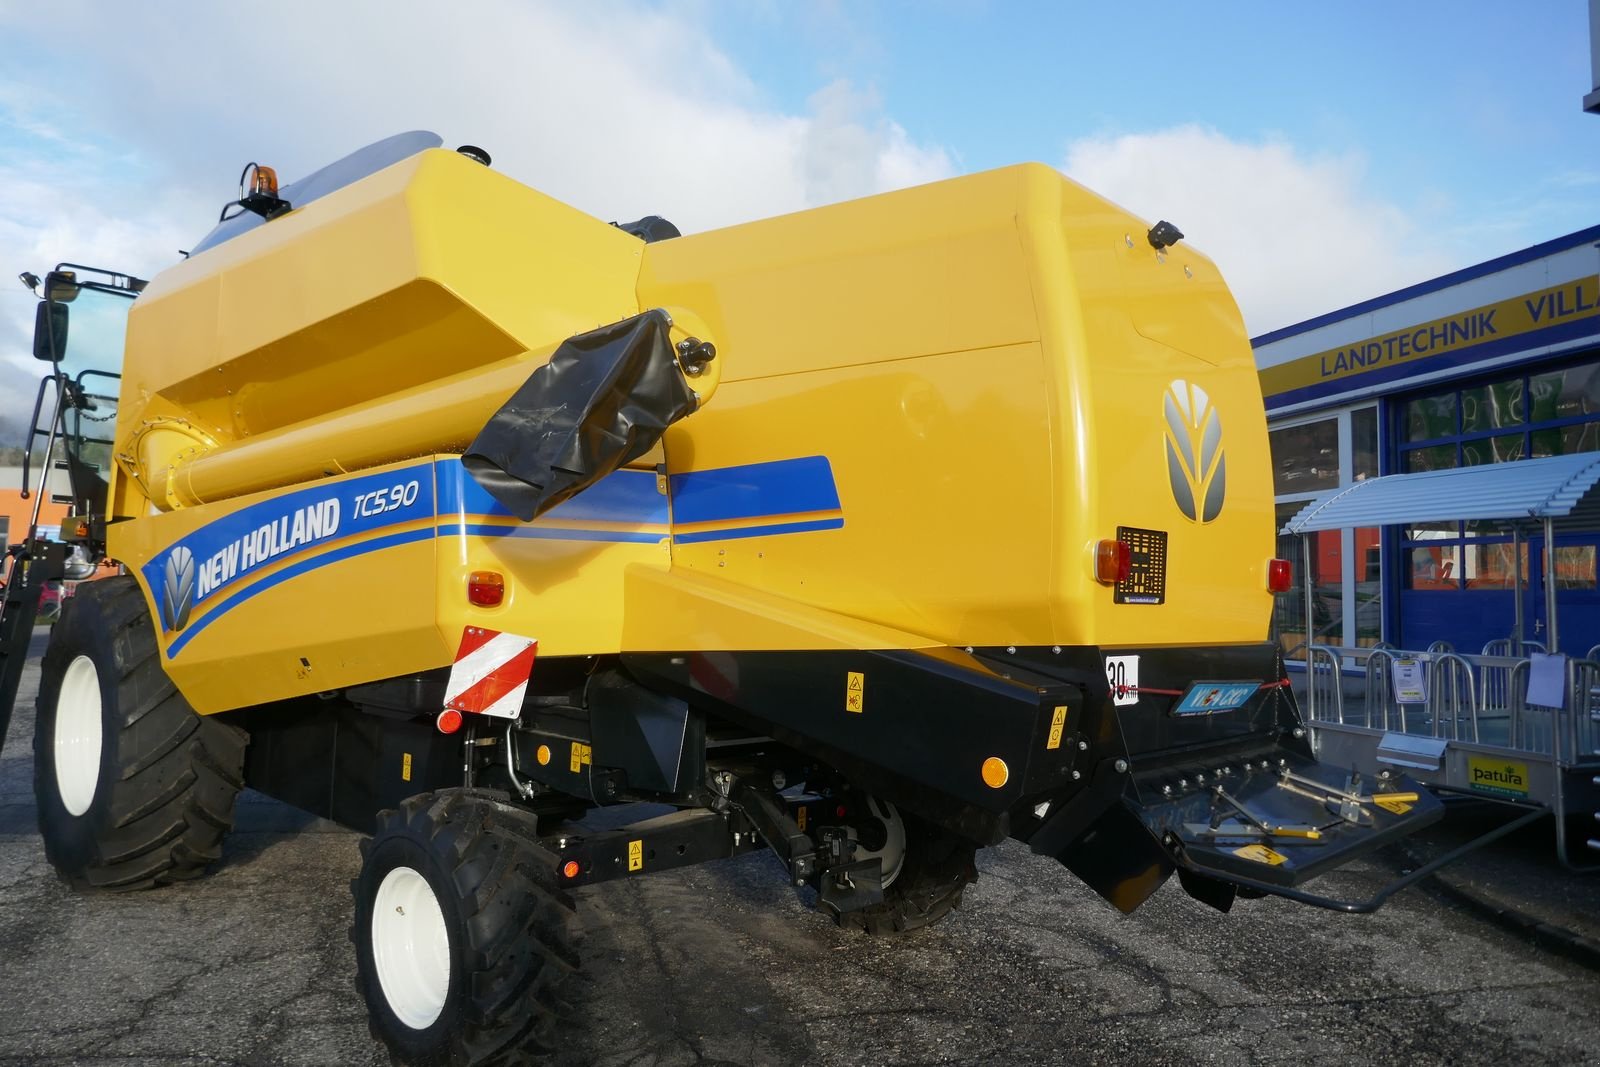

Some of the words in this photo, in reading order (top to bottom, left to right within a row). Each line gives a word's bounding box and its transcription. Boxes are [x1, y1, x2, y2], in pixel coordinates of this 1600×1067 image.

[1320, 309, 1497, 377] LANDTECHNIK
[1525, 285, 1600, 323] VILL
[353, 480, 419, 520] TC5.90
[197, 539, 241, 600] NEW
[241, 497, 341, 572] HOLLAND
[1108, 661, 1125, 701] 30
[1473, 766, 1523, 786] patura
